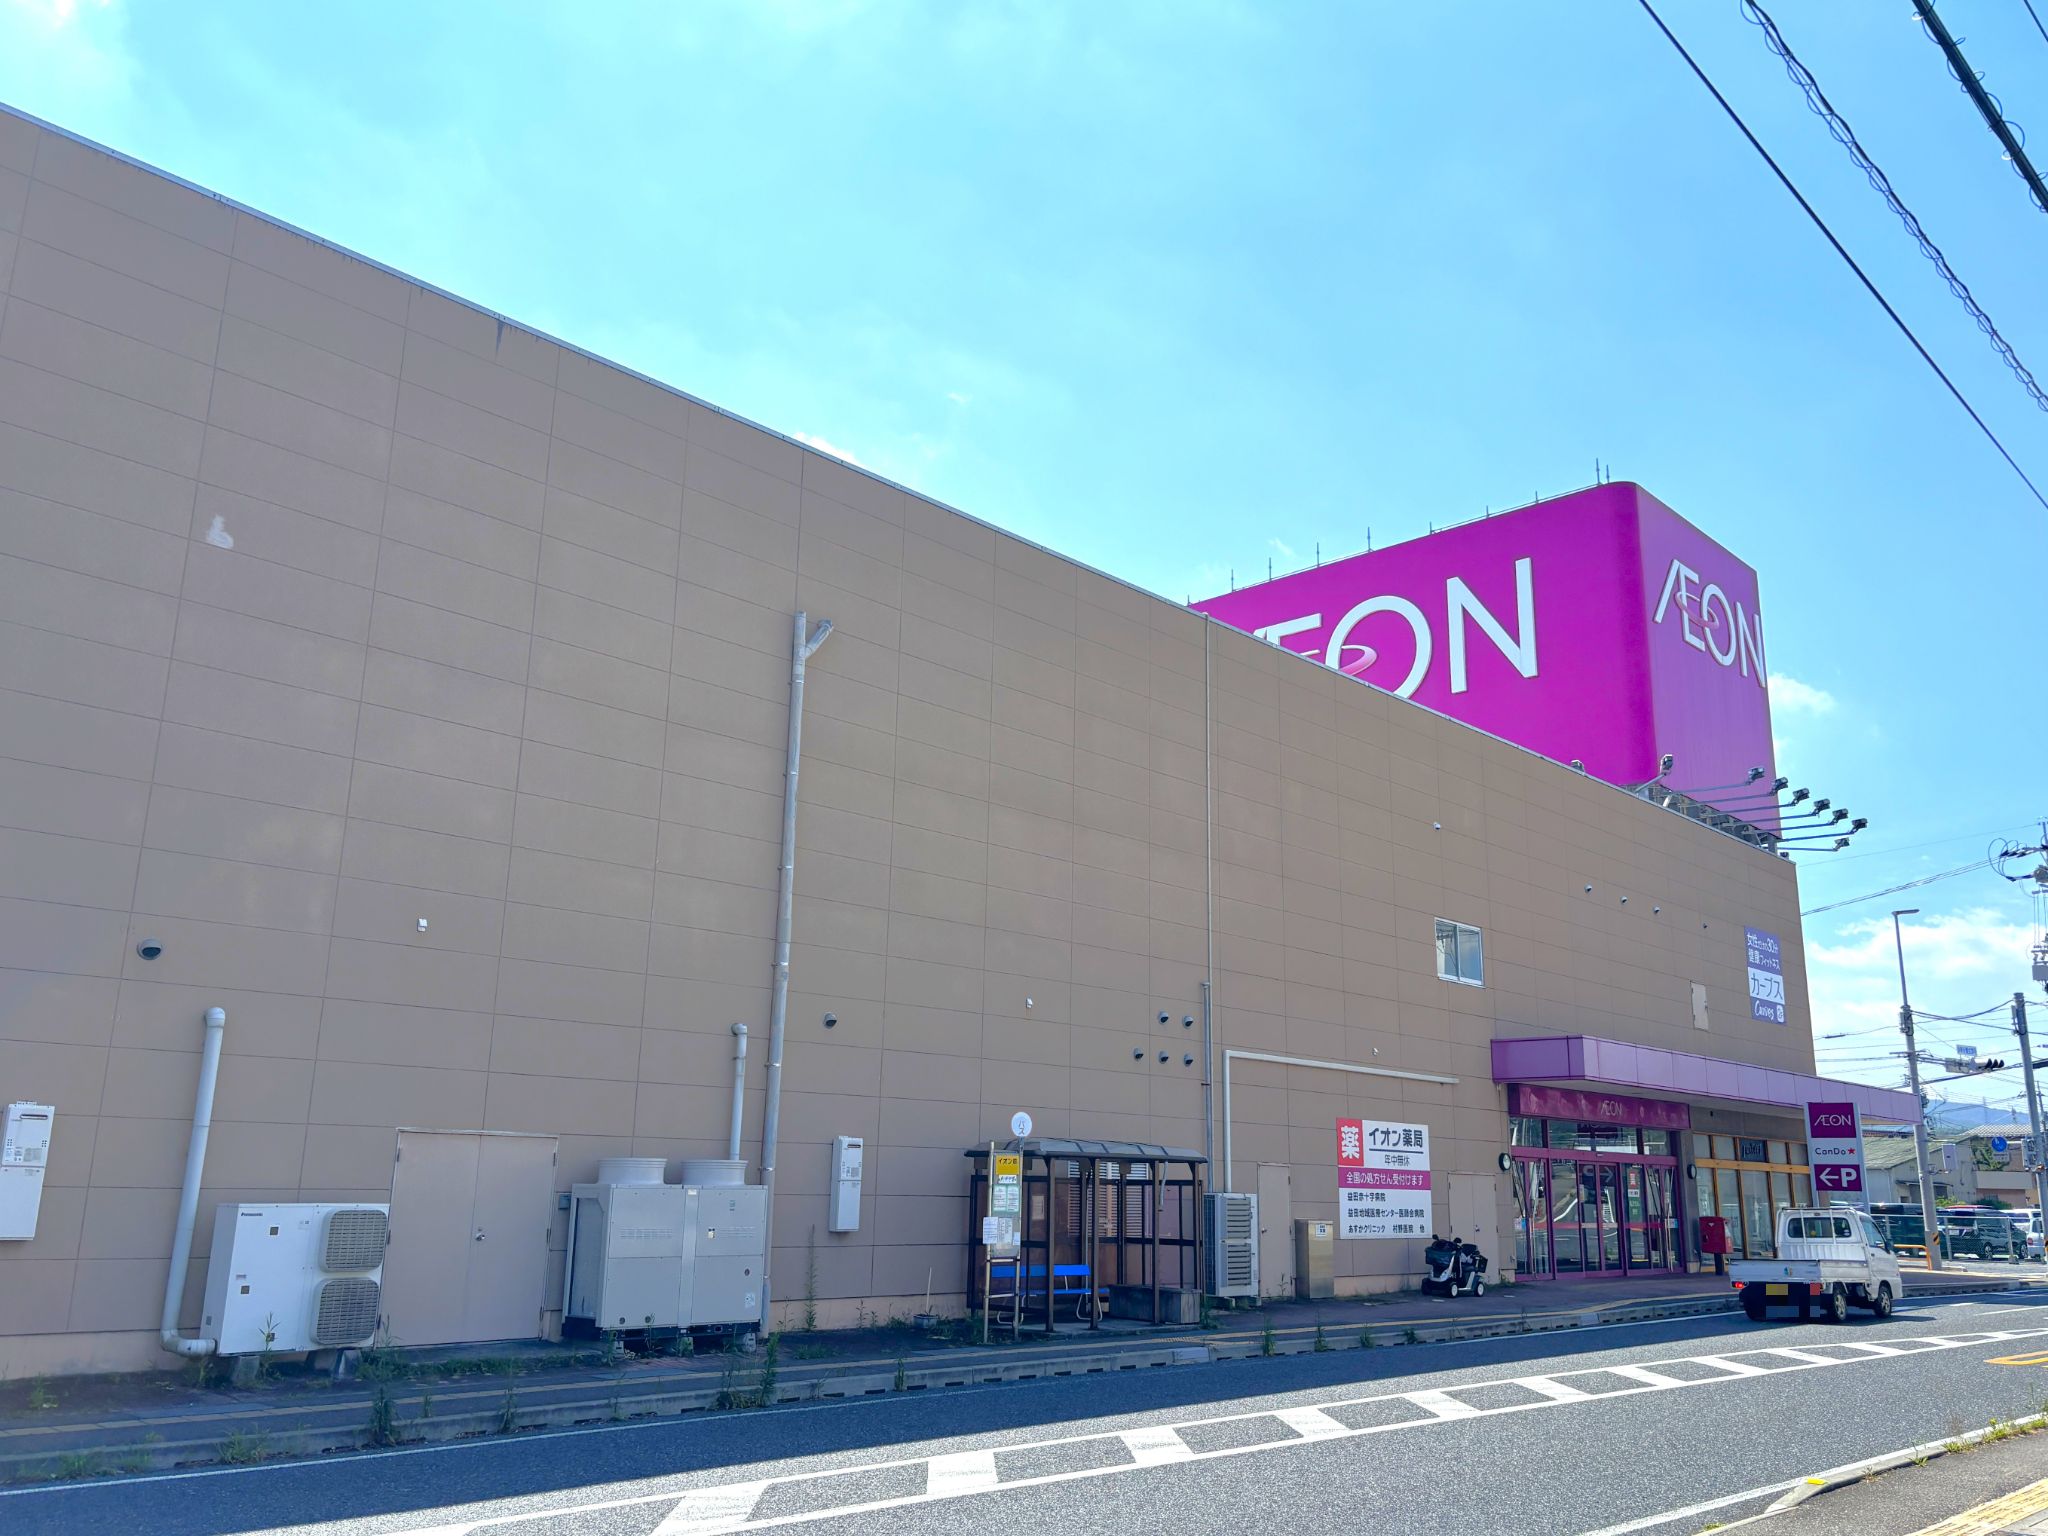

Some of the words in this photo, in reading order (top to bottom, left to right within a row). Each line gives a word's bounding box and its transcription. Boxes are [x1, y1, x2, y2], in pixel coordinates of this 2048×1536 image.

[1341, 1125, 1360, 1159] 薬
[1368, 1127, 1424, 1149] イオン薬局
[1815, 1147, 1846, 1156] CanDo
[1384, 1154, 1411, 1167] 年中無休
[1346, 1171, 1424, 1186] 全国の処方せん受付けます
[1840, 1167, 1857, 1188] P
[1348, 1224, 1386, 1234] あすかクリニック
